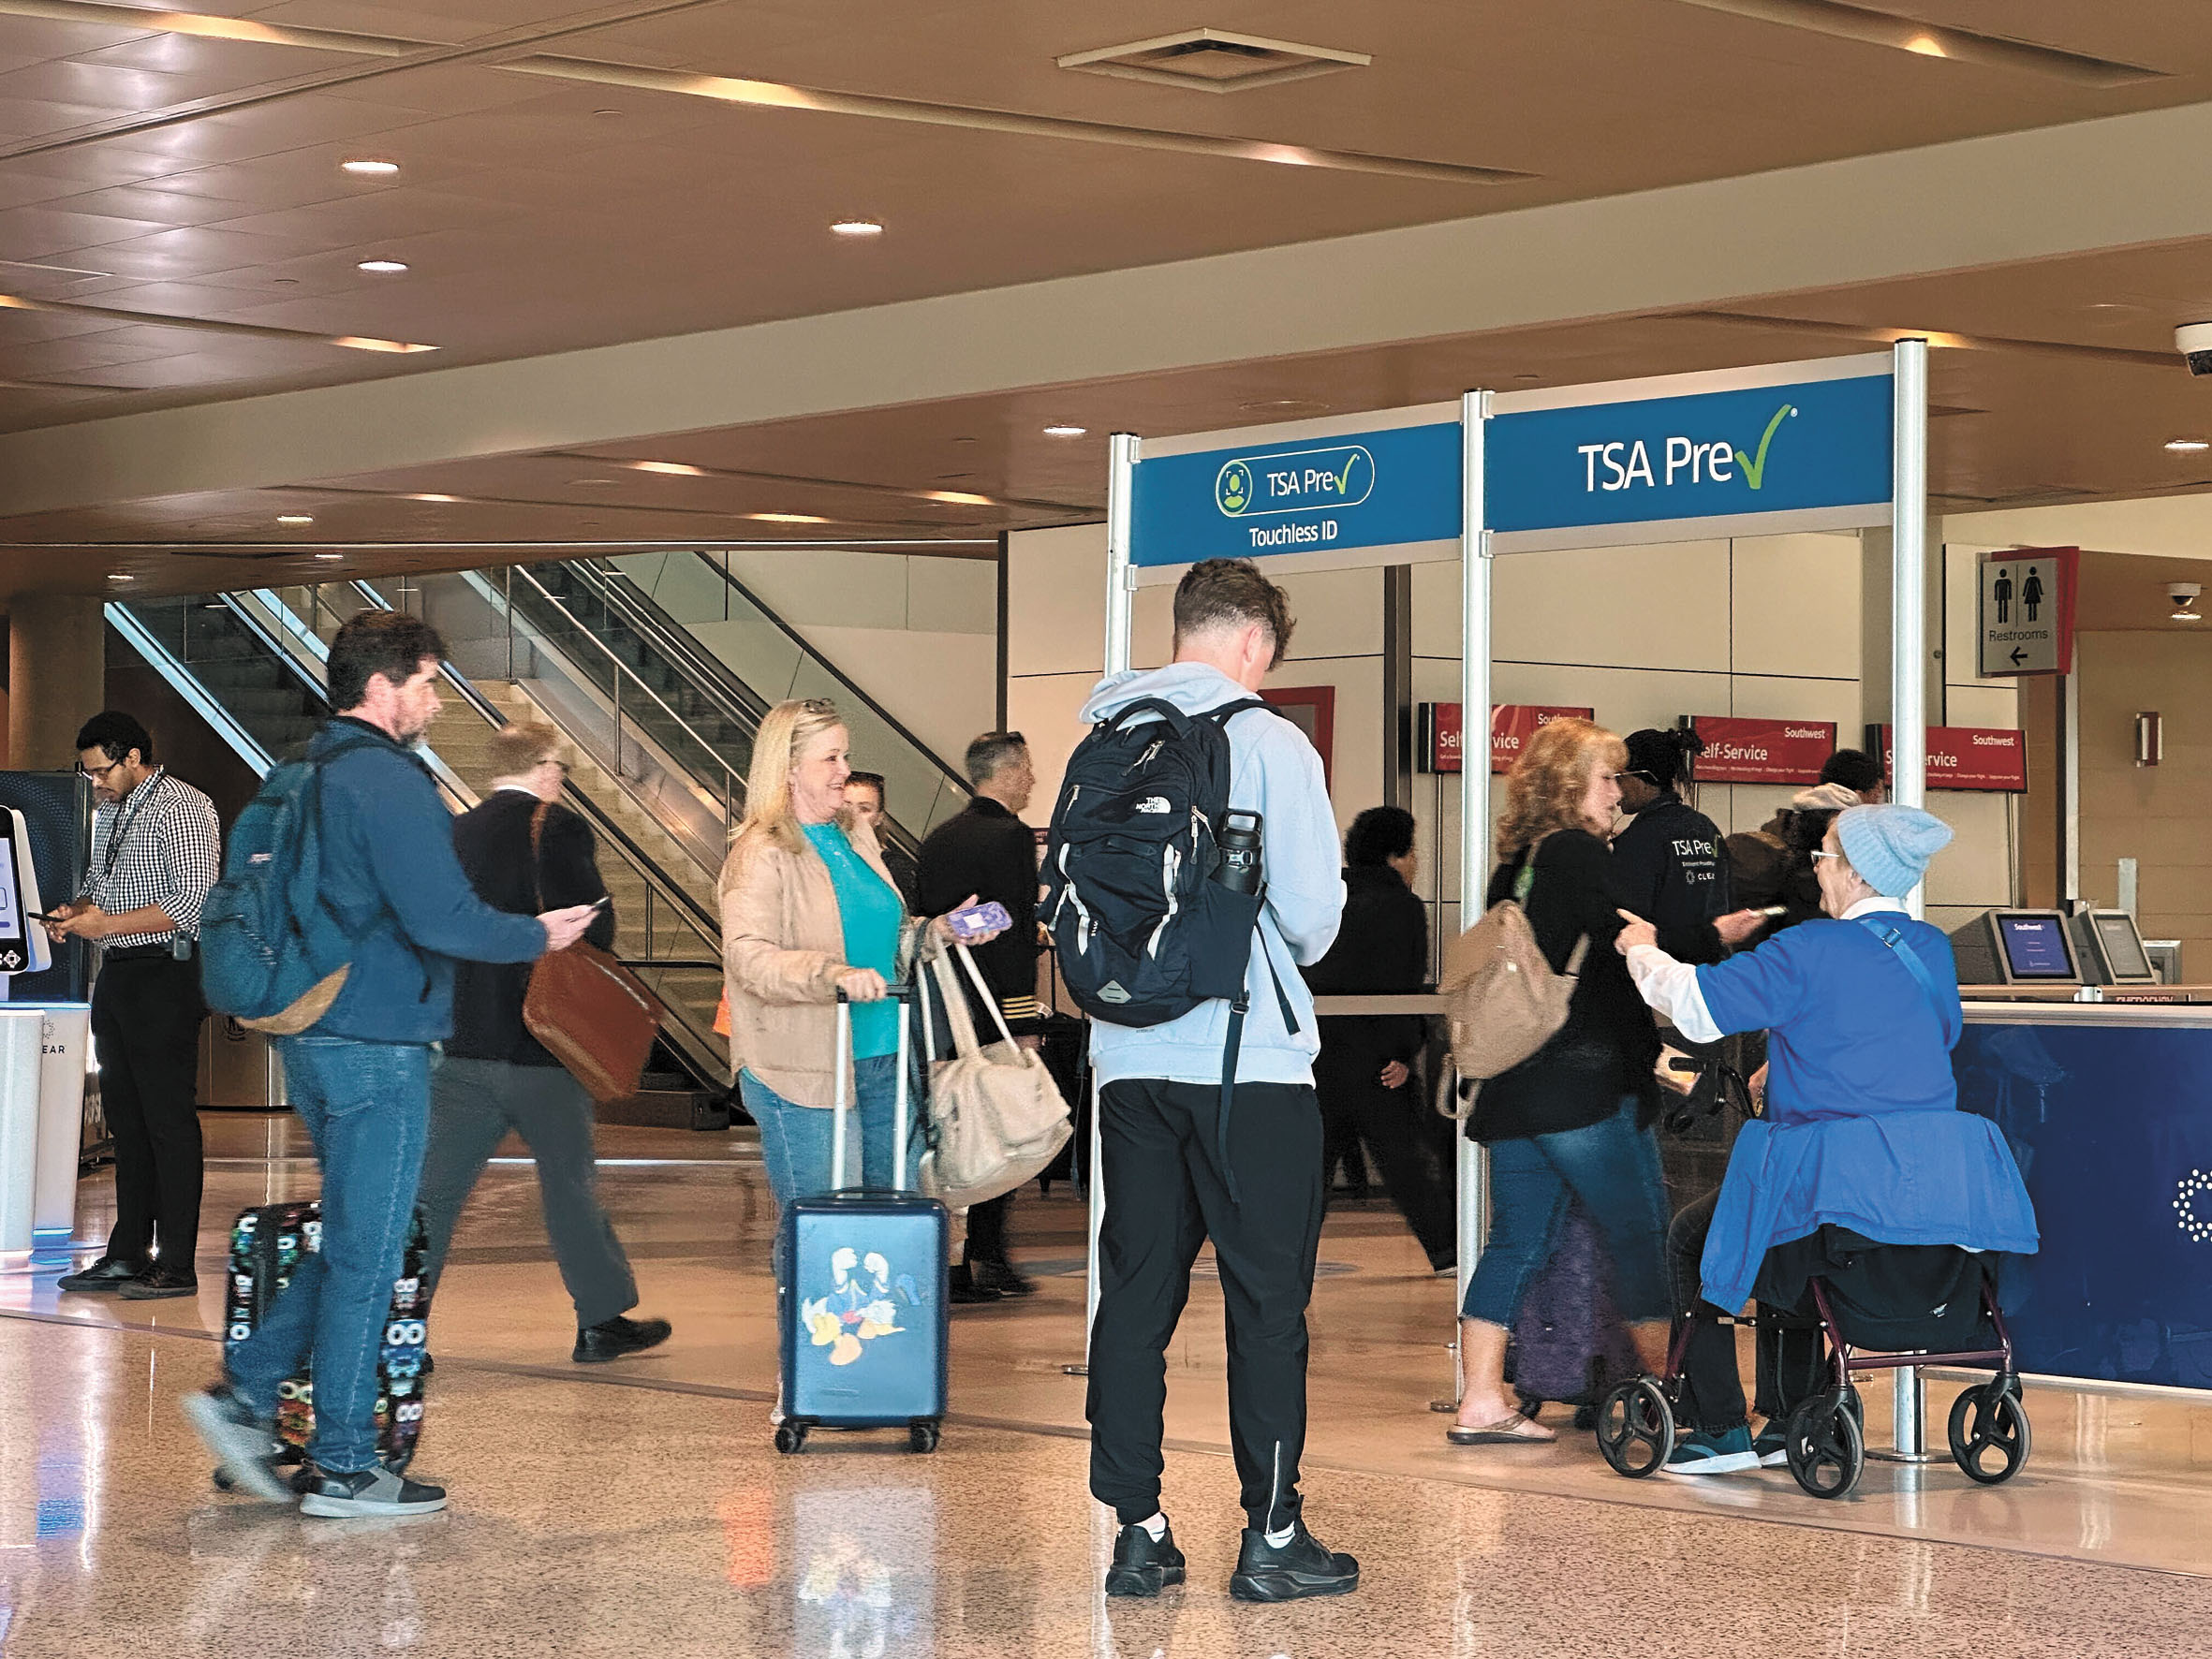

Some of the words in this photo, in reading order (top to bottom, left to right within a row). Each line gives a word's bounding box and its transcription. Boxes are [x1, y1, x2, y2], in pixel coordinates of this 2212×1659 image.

[1578, 440, 1655, 492] TSA
[1666, 436, 1733, 486] Pre
[1266, 471, 1301, 497] TSA
[1305, 469, 1334, 492] Pre
[1248, 522, 1320, 548] Touchless
[1321, 520, 1338, 541] ID
[1988, 629, 2049, 642] Restrooms
[1784, 727, 1826, 740] Southwest
[1972, 734, 2015, 747] Southwest
[1698, 742, 1768, 761] elf-Service
[1672, 840, 1694, 857] TSA
[1692, 840, 1712, 855] Pre
